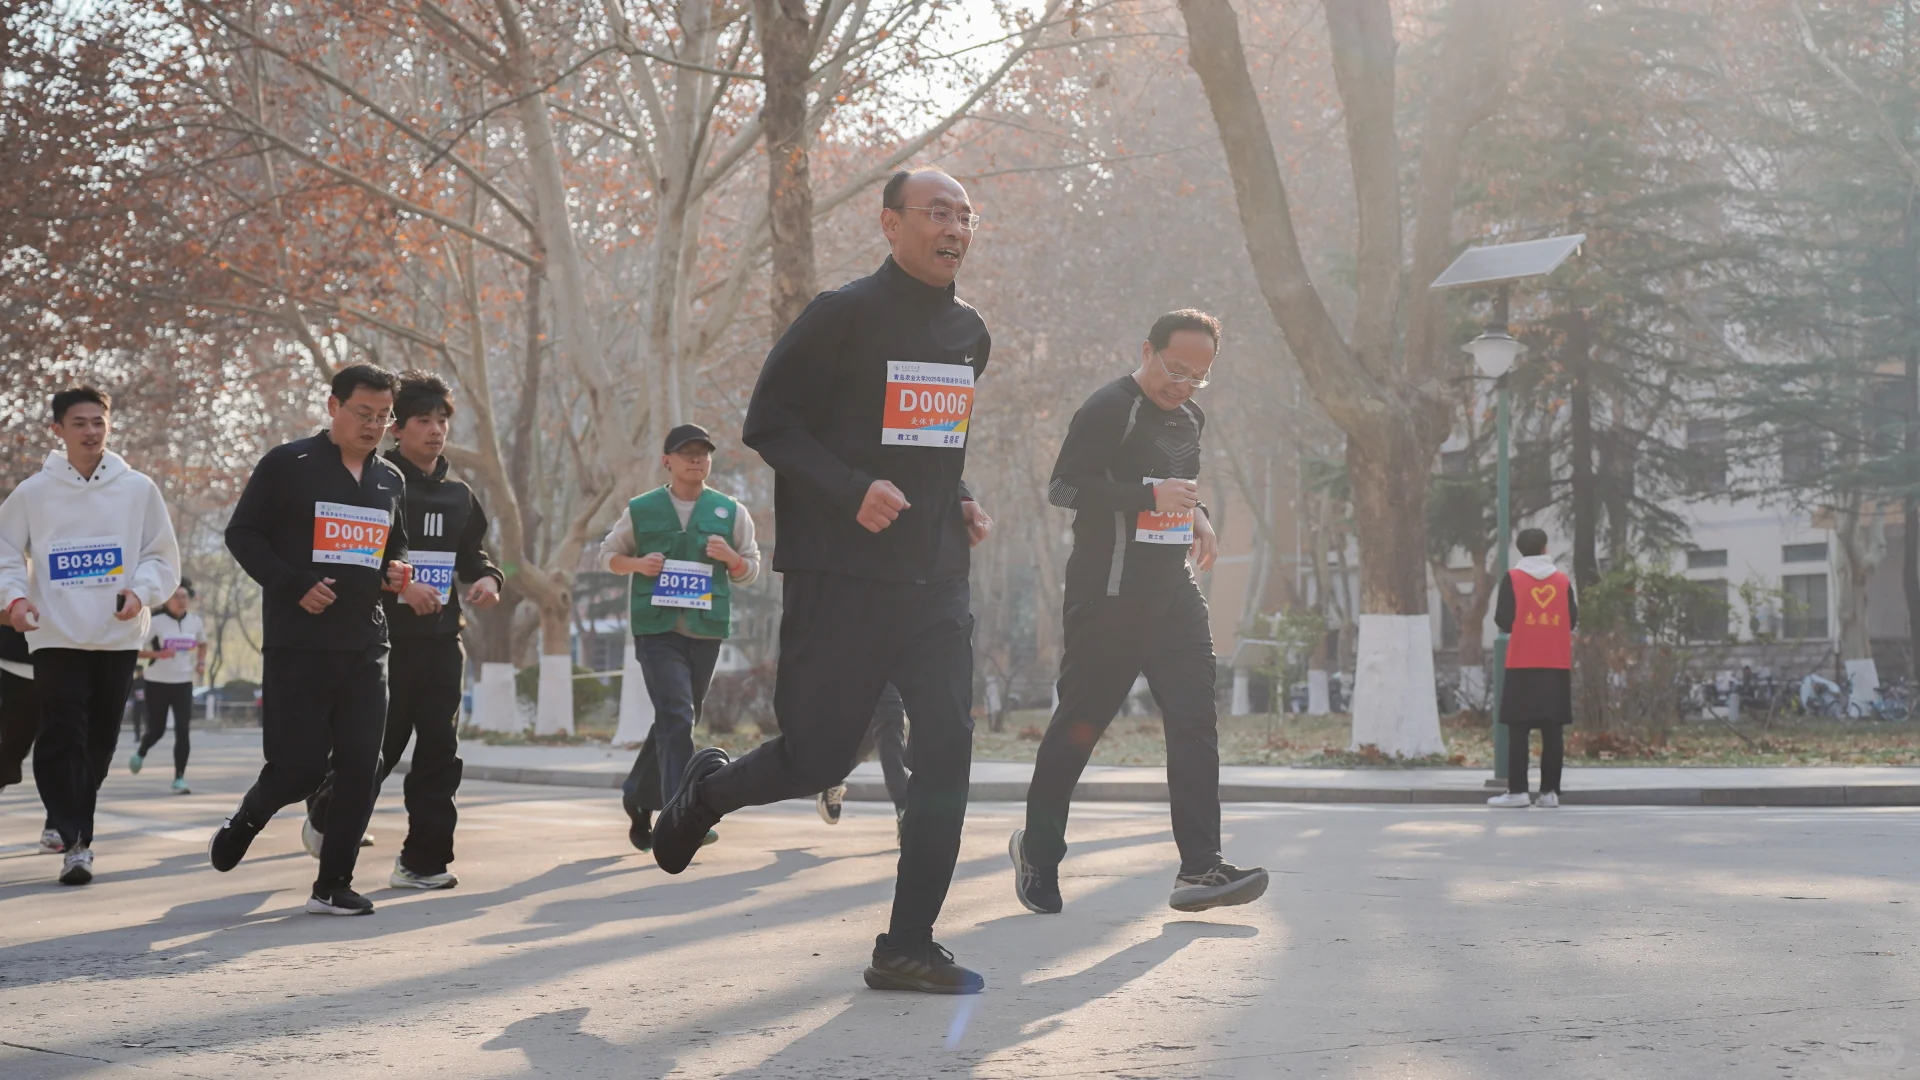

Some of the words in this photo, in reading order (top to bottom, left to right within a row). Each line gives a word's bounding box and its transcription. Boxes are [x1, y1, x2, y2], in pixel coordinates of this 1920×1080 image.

[899, 389, 968, 415] D0006
[325, 521, 384, 545] D0012
[57, 551, 116, 571] B0349
[414, 567, 452, 584] 035
[659, 573, 706, 591] B0121
